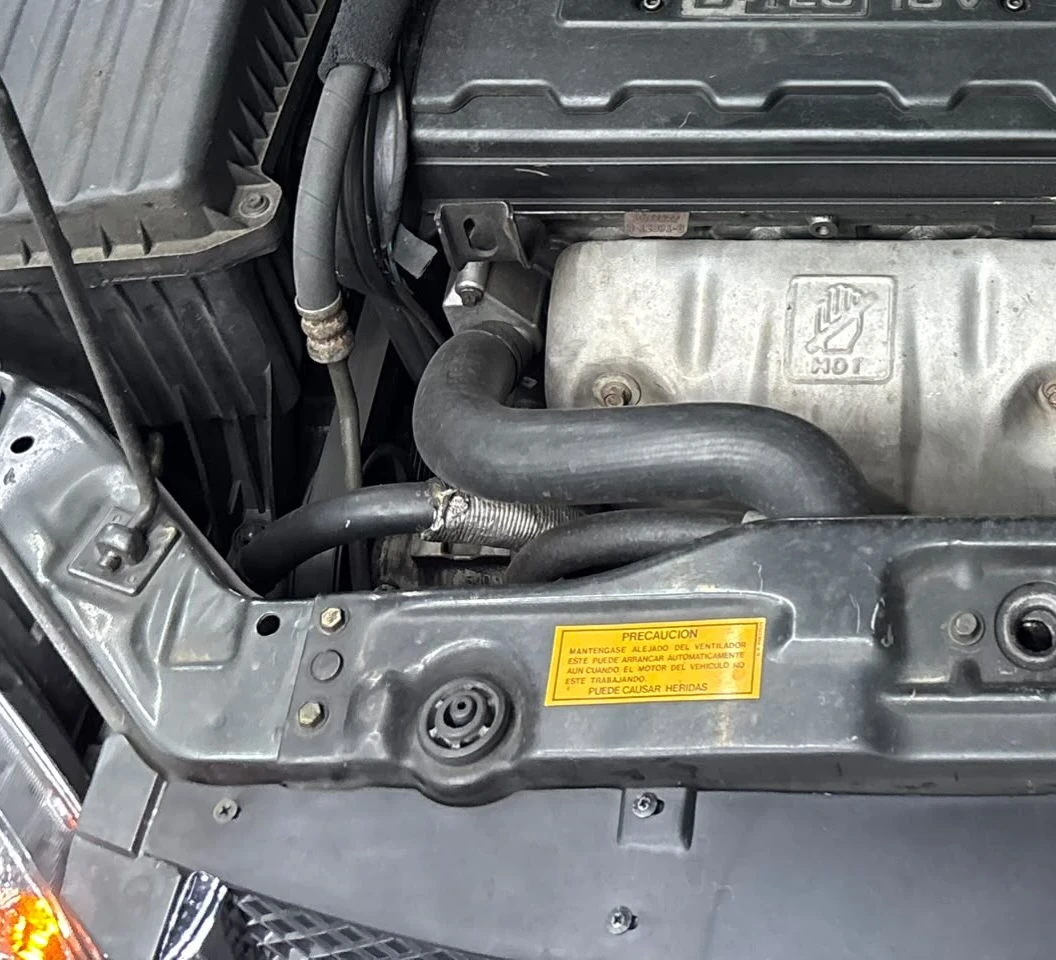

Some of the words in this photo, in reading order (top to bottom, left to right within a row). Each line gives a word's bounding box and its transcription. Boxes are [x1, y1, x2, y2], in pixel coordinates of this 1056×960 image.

[811, 357, 865, 375] HOT
[622, 629, 698, 642] PRECAUCION
[569, 646, 627, 655] MANTENGASE
[632, 644, 669, 653] ALEJADO
[674, 643, 690, 651] DEL
[695, 641, 747, 650] VENTILADOR
[567, 657, 589, 665] ESTE
[592, 656, 620, 664] PUEDE
[621, 655, 665, 663] ARRANCAR
[668, 651, 745, 661] AUTOMATICAMENTE
[567, 667, 584, 675] AUN
[585, 666, 620, 674] CUANDO
[623, 665, 634, 673] EL
[638, 664, 667, 672] MOTOR
[671, 663, 686, 671] DEL
[690, 661, 730, 670] VEHICULO
[733, 661, 746, 669] NO
[565, 677, 586, 685] ESTE
[588, 686, 620, 696] PUEDE
[622, 684, 662, 695] CAUSAR
[665, 682, 708, 693] HERIDAS
